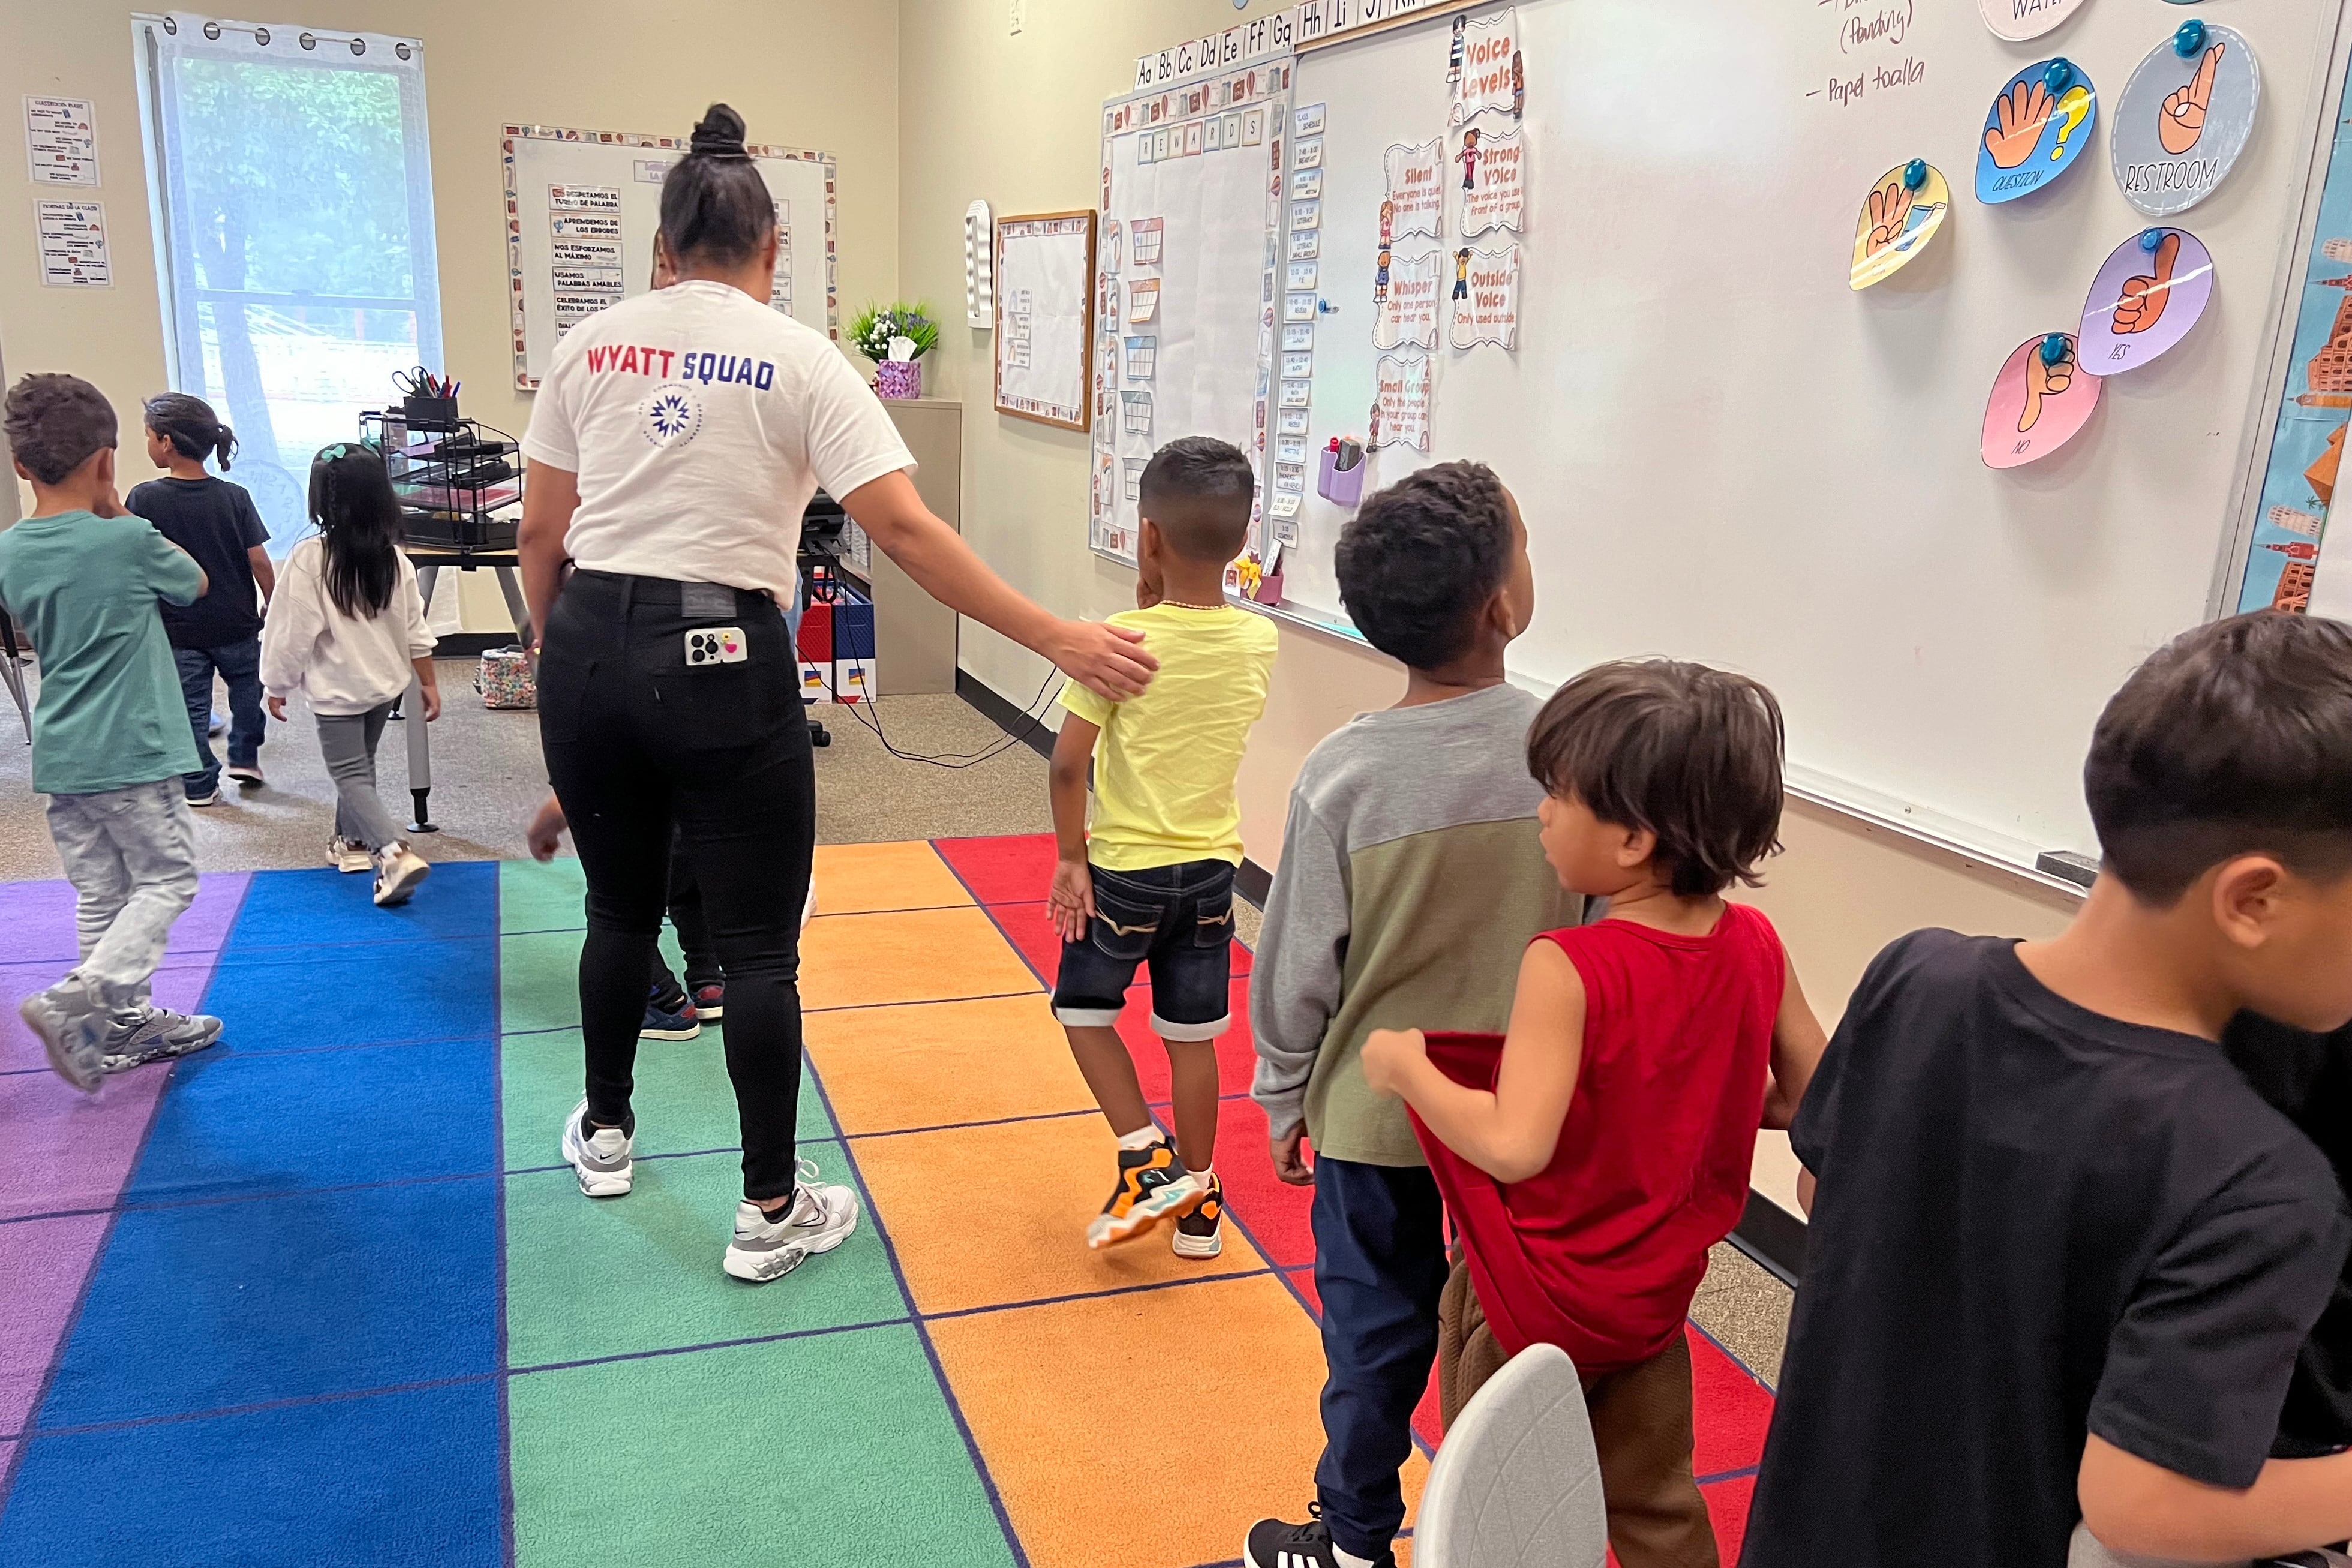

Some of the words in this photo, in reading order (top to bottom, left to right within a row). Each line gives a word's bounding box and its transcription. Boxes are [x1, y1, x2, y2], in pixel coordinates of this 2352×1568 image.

[1138, 59, 1151, 86] Aa
[1158, 52, 1172, 80] Bb
[1178, 46, 1192, 74] Cc
[1200, 35, 1216, 68] Dd
[1224, 32, 1237, 62] Ee
[1249, 19, 1265, 54] Ff
[1303, 2, 1320, 37] Hh
[1467, 37, 1510, 68] Voice
[1872, 55, 1924, 90] toalla
[1462, 65, 1510, 100] Levels
[1483, 145, 1520, 166] Strong
[1405, 165, 1433, 185] Silent
[1484, 167, 1517, 187] Voice
[1992, 170, 2045, 192] QUESTION
[2125, 158, 2219, 194] RESTROOM
[1467, 193, 1479, 204] The
[1480, 191, 1498, 202] voice
[1500, 189, 1510, 202] you
[564, 218, 608, 226] APRENDEMOS
[570, 245, 615, 253] ESFORZAMOS
[1471, 269, 1513, 288] Outside
[1393, 279, 1433, 298] Whisper
[1387, 300, 1402, 313] Only
[1475, 290, 1506, 308] Voice
[1456, 312, 1474, 326] Only
[1476, 312, 1492, 324] used
[2108, 342, 2131, 361] YES
[587, 344, 675, 379] WYATT
[682, 352, 775, 391] SQUAD
[1379, 379, 1404, 393] Small
[1404, 379, 1431, 397] Group
[1383, 396, 1396, 409] Only
[2011, 439, 2031, 455] NO
